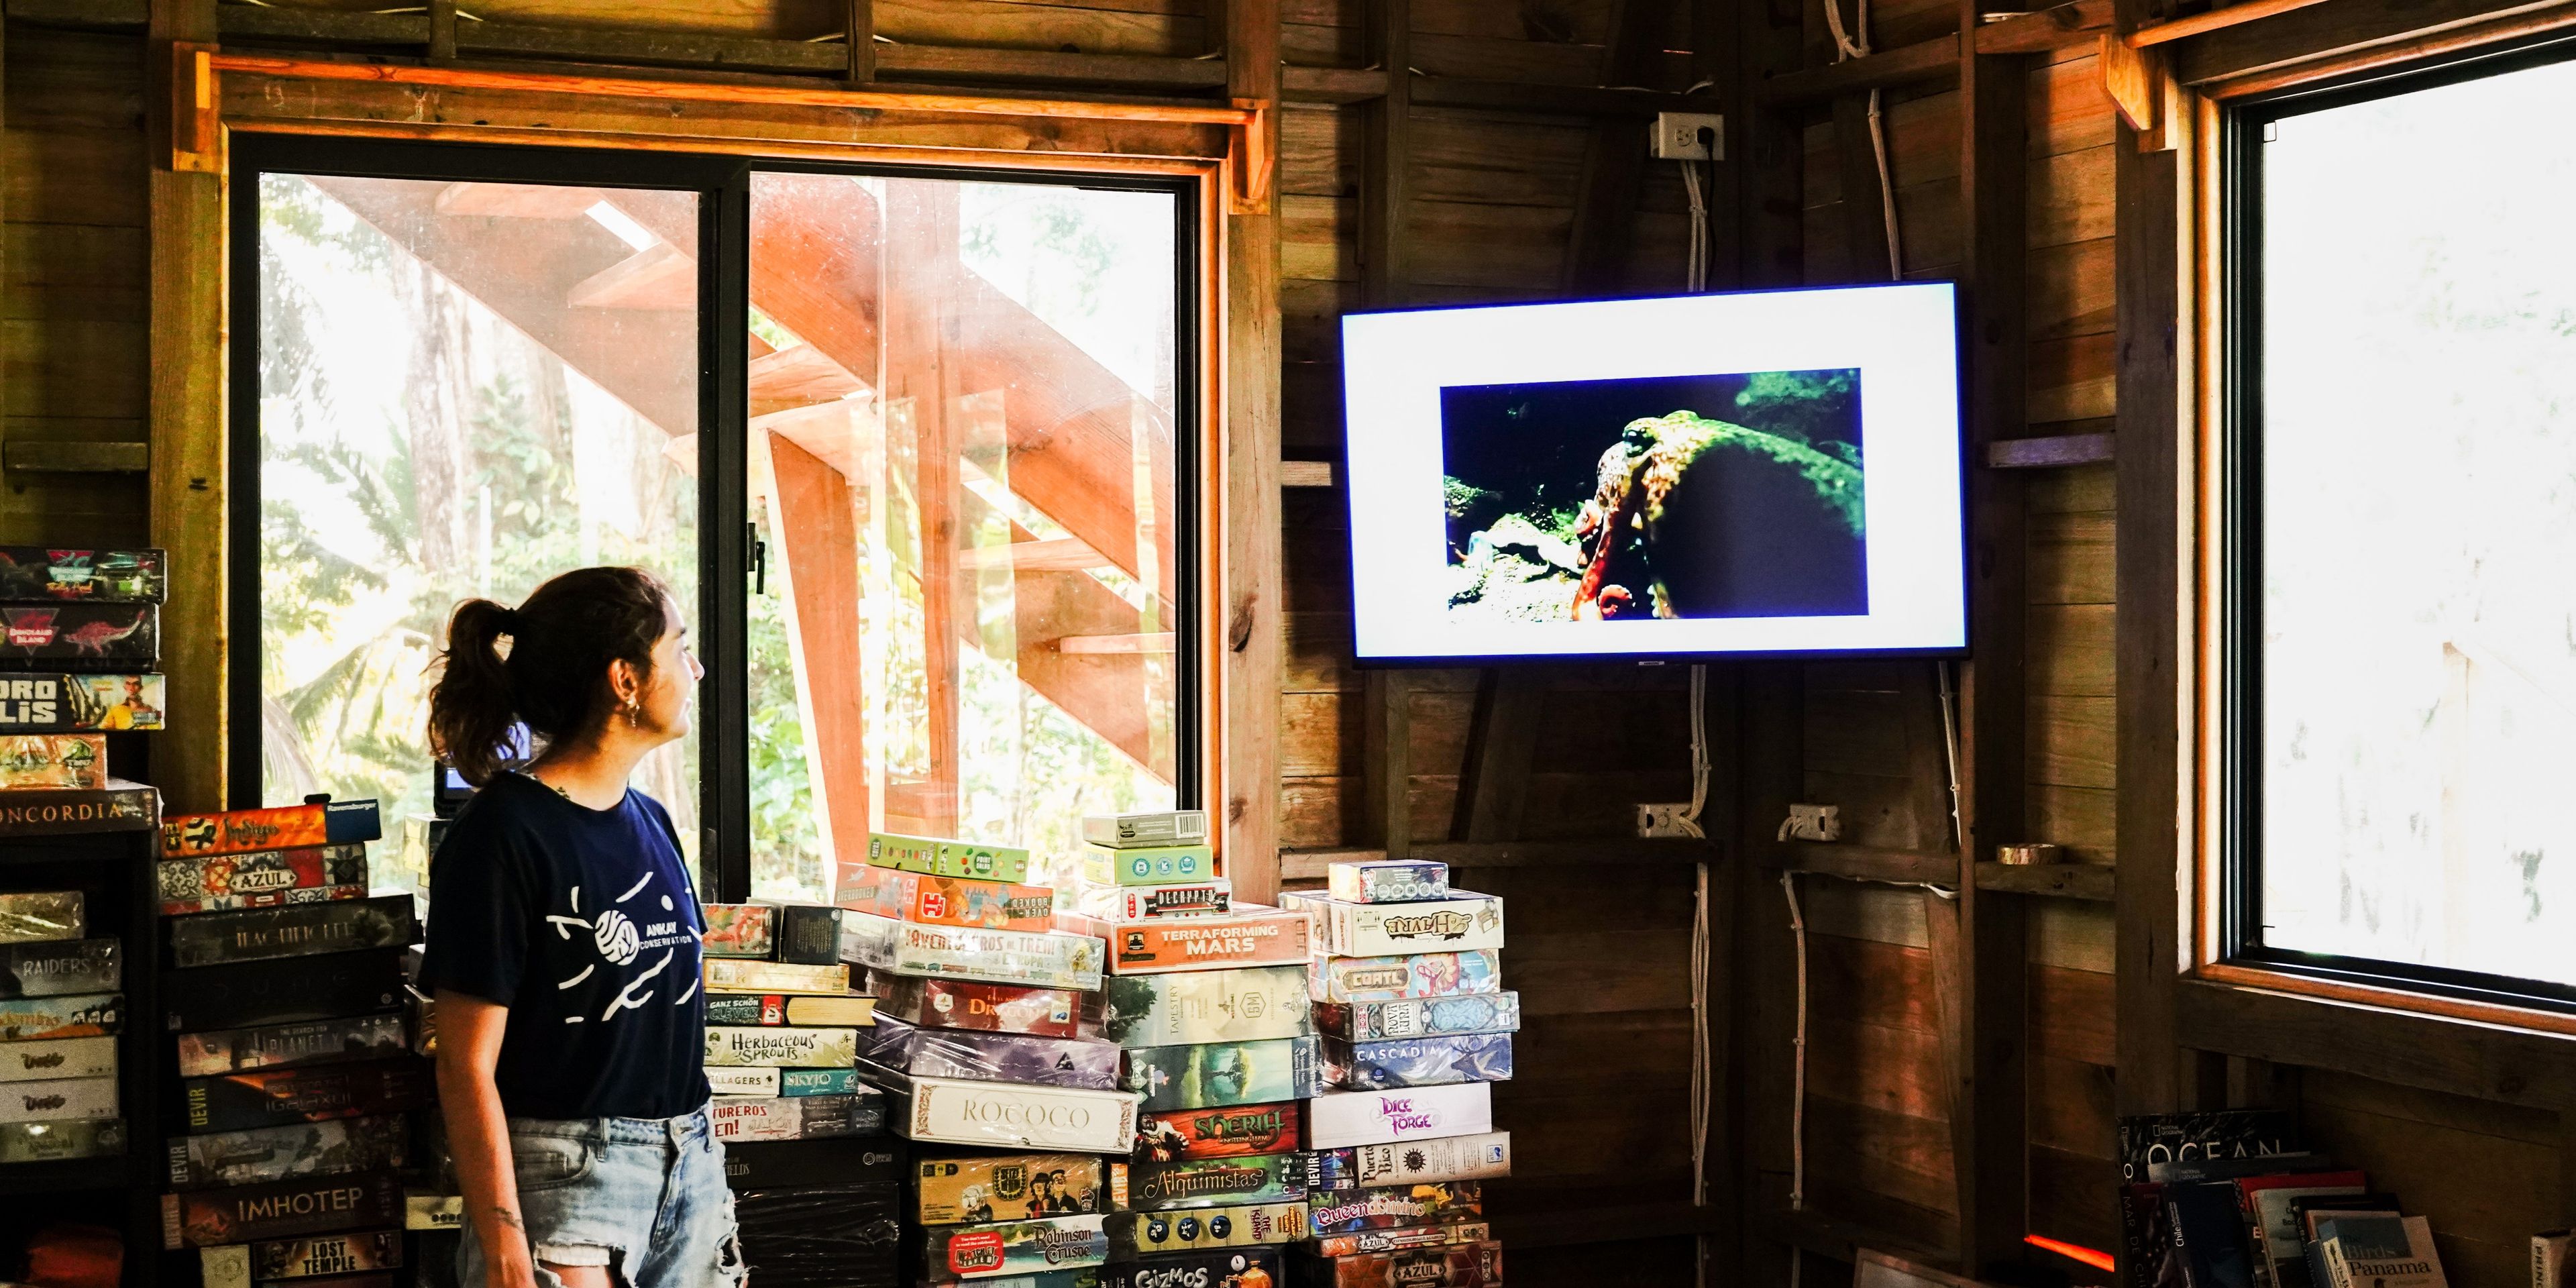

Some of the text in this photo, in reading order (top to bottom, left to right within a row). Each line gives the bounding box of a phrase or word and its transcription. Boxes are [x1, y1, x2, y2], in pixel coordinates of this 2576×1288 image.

[0, 803, 123, 824] NCORDIA
[239, 874, 288, 888] AZUL
[1159, 889, 1216, 904] DECRYPTO
[1161, 925, 1279, 942] TERRAFORMING
[1186, 937, 1256, 956] MARS
[22, 957, 91, 977] RAIDERS
[709, 998, 759, 1009] GANZ SCHÖN
[1170, 984, 1179, 1036] TAPESTRY
[1356, 1046, 1440, 1062] CASCADIA
[188, 1087, 208, 1127] DEVIR
[963, 1099, 1090, 1128] ROCOCO
[172, 1144, 189, 1183] DEVIR
[1307, 1155, 1320, 1187] DEVIR
[1144, 1169, 1264, 1199] Alquimistas
[237, 1186, 364, 1222] IMHOTEP
[1261, 1216, 1271, 1234] THE
[1032, 1225, 1093, 1249] Robinson
[1362, 1238, 1385, 1248] AZUL
[2174, 1226, 2185, 1247] Chile
[311, 1241, 346, 1258] LOST
[1044, 1243, 1091, 1266] Crusoe
[2345, 1244, 2396, 1259] Birds
[303, 1256, 356, 1275] TEMPLE
[1403, 1265, 1438, 1279] AZUL
[2349, 1260, 2432, 1276] Panama
